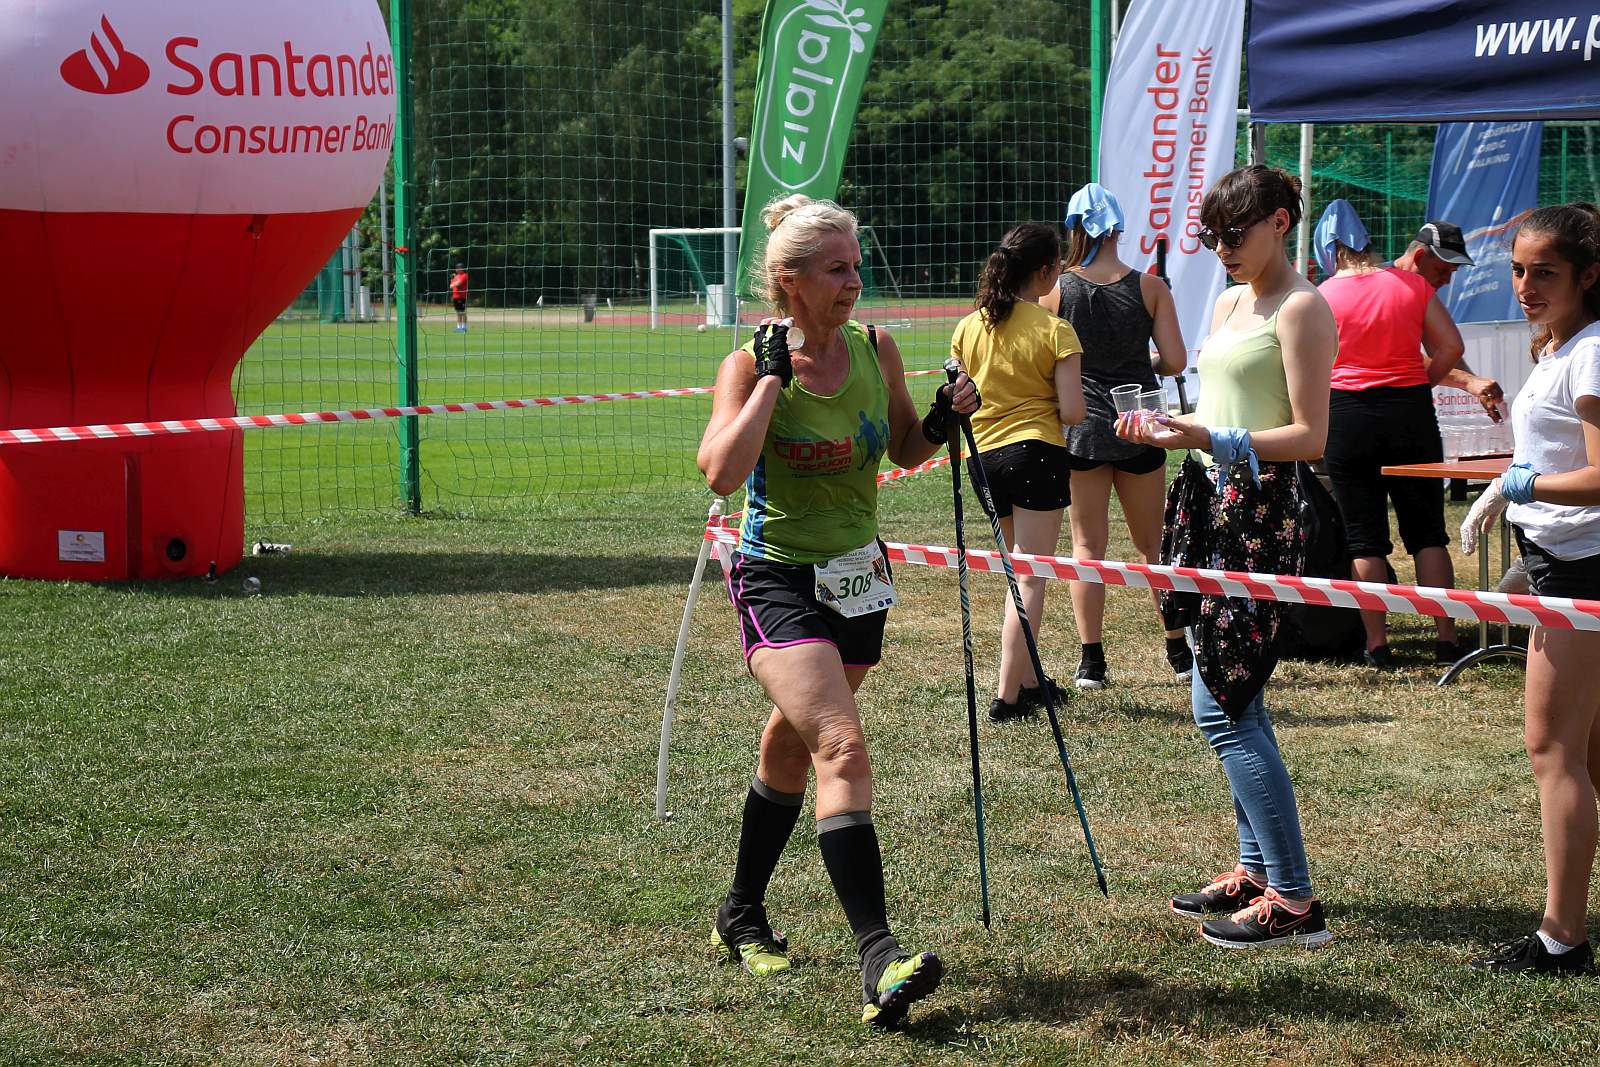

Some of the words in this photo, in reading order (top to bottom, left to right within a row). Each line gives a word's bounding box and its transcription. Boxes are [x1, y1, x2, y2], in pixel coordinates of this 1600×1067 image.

[165, 36, 394, 97] Santander
[1188, 46, 1213, 113] Bank
[166, 115, 351, 154] Consumer
[352, 113, 394, 152] Bank
[1140, 43, 1181, 255] Santander
[1179, 119, 1208, 255] Consumer
[836, 571, 873, 600] 308
